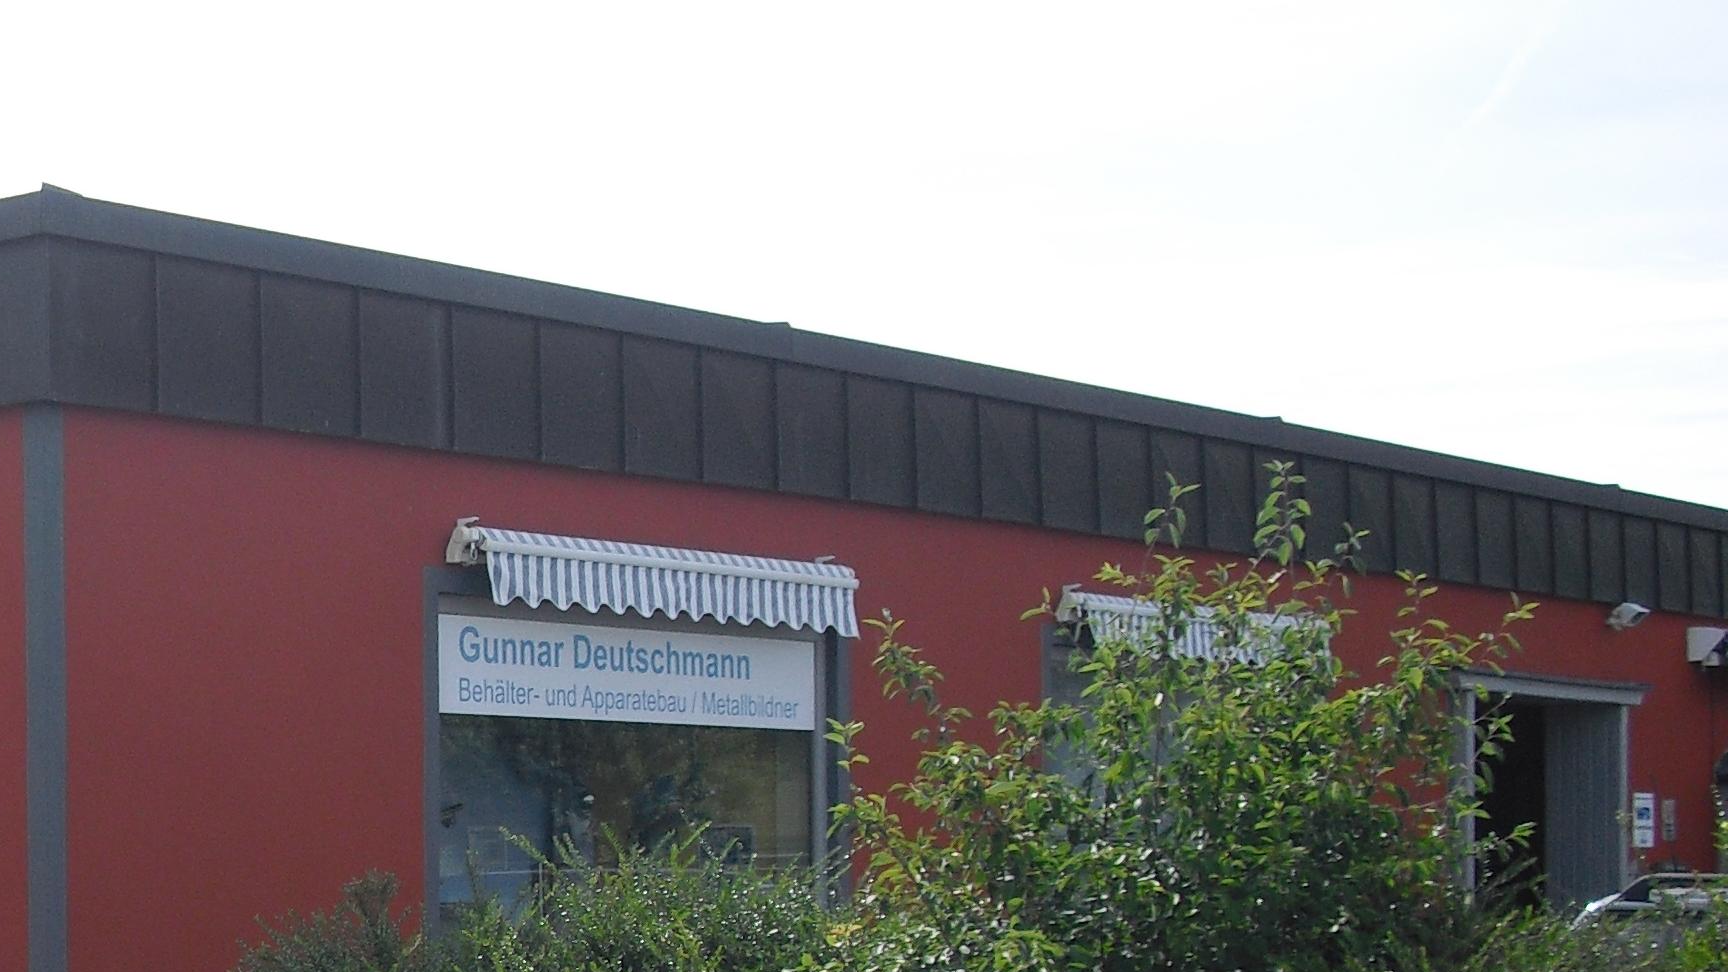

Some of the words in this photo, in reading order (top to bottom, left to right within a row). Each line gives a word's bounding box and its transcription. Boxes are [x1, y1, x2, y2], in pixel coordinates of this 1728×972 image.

[458, 625, 565, 668] Gunnar
[572, 633, 751, 681] Deutschmann
[458, 676, 540, 705] Behälter-
[545, 684, 576, 708] und
[580, 684, 687, 716] Apparatebau
[702, 690, 799, 720] Metallbildner
